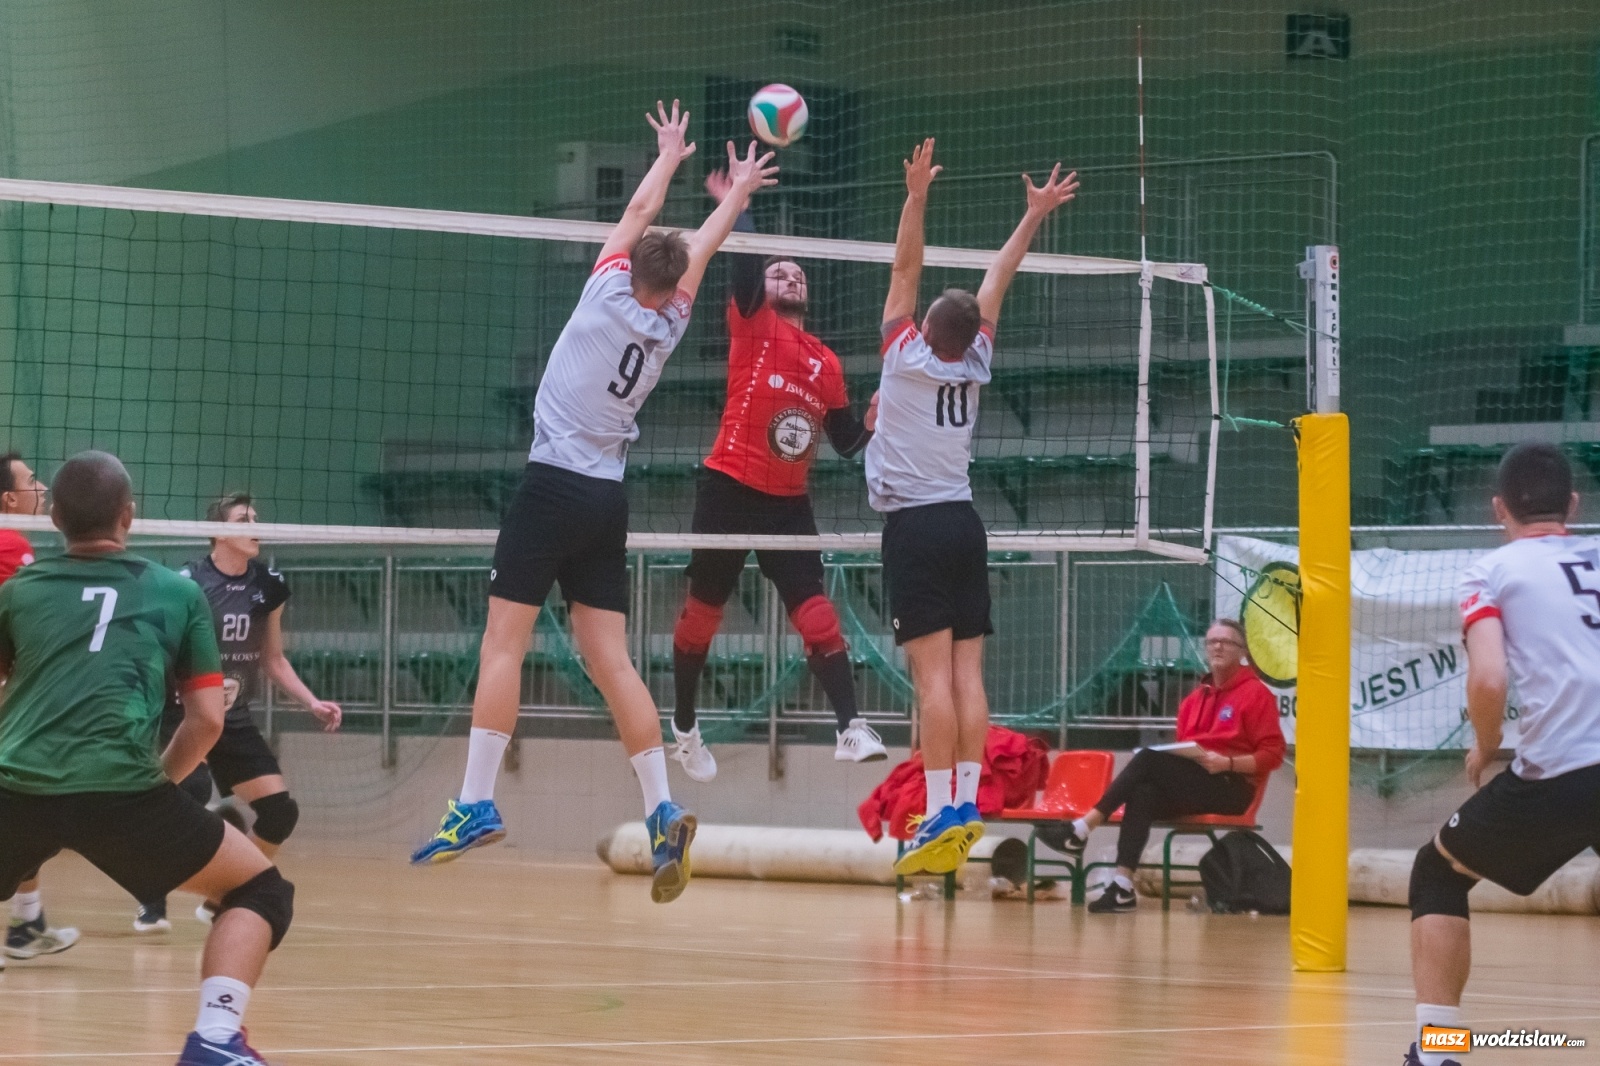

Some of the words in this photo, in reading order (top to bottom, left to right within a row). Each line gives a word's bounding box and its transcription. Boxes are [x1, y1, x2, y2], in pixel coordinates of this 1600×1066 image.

[607, 342, 645, 399] 9
[808, 357, 822, 382] 7
[936, 382, 969, 428] 10
[82, 586, 118, 652] 7
[1558, 561, 1600, 630] 5
[222, 613, 250, 641] 20
[1352, 658, 1421, 711] JEST
[1428, 644, 1456, 679] W
